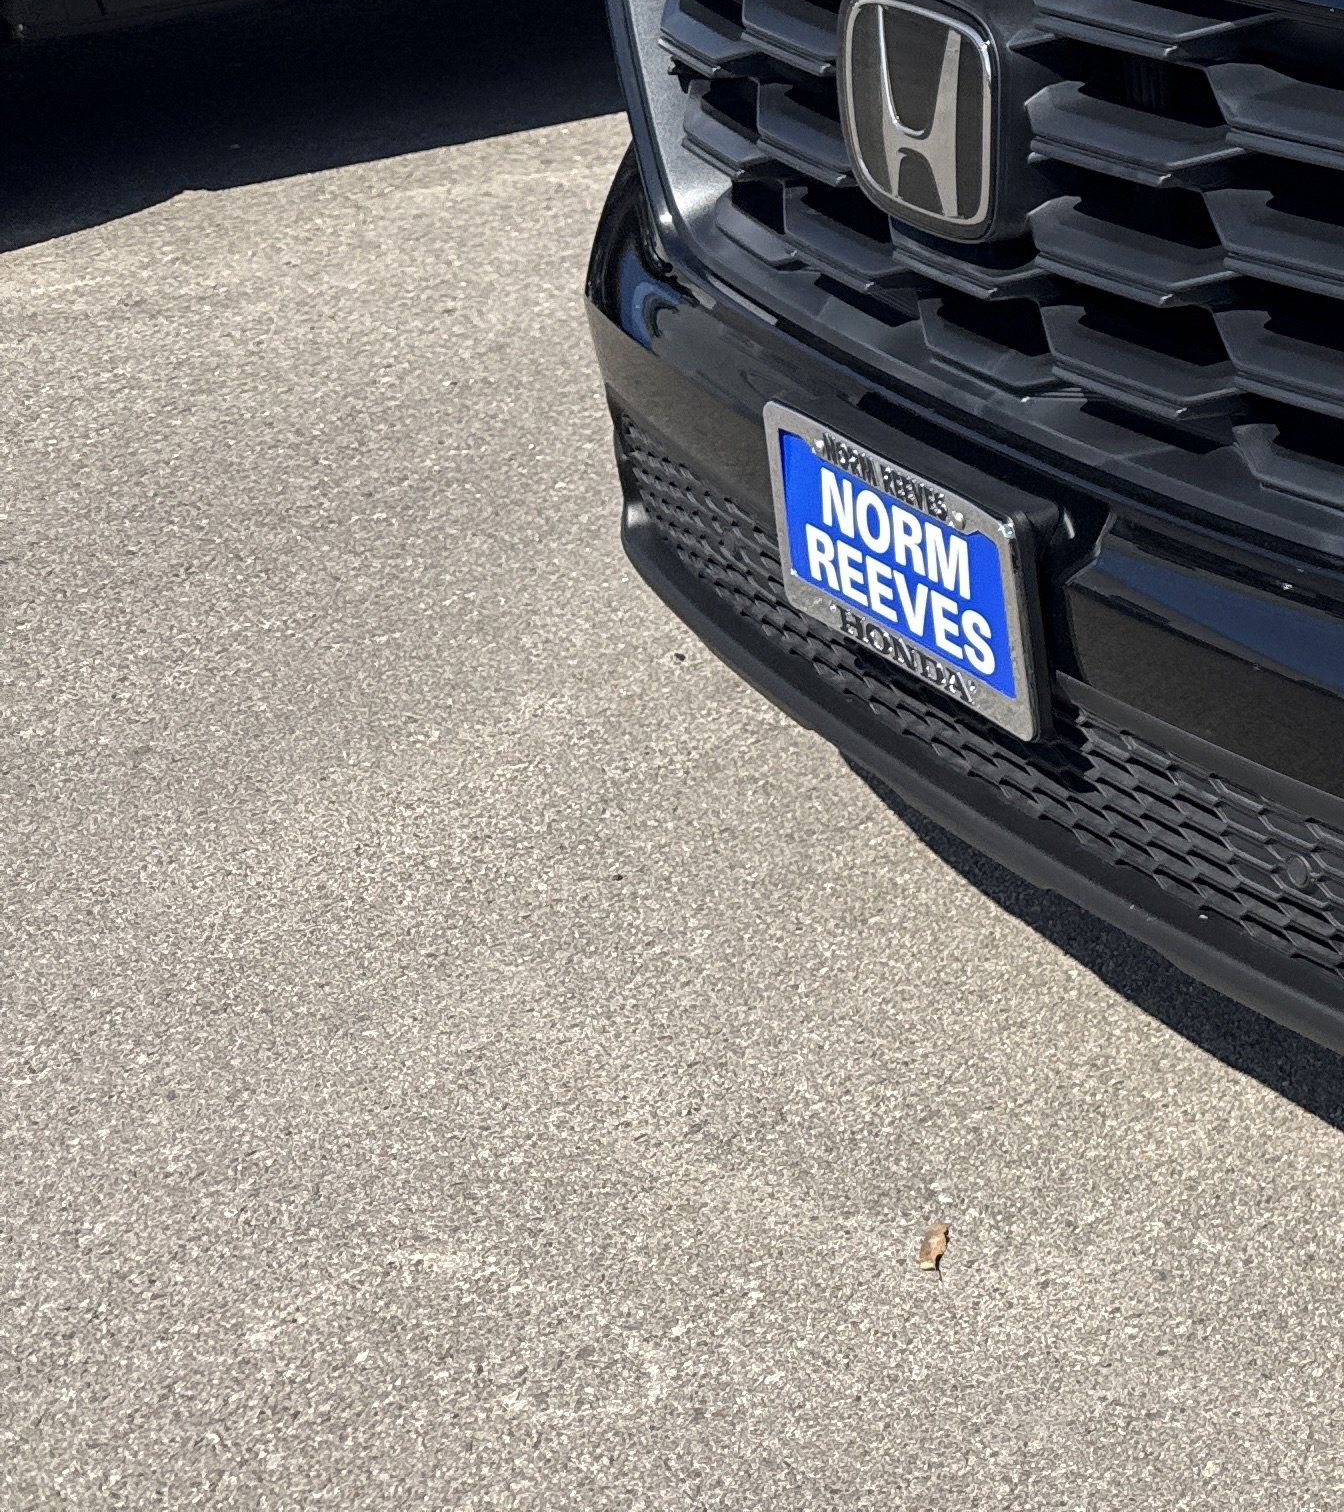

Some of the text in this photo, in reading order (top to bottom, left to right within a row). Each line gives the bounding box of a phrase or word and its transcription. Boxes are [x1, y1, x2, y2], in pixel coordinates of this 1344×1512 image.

[805, 523, 996, 676] REEVES
[820, 466, 971, 600] NORM
[839, 606, 977, 705] HONDA
